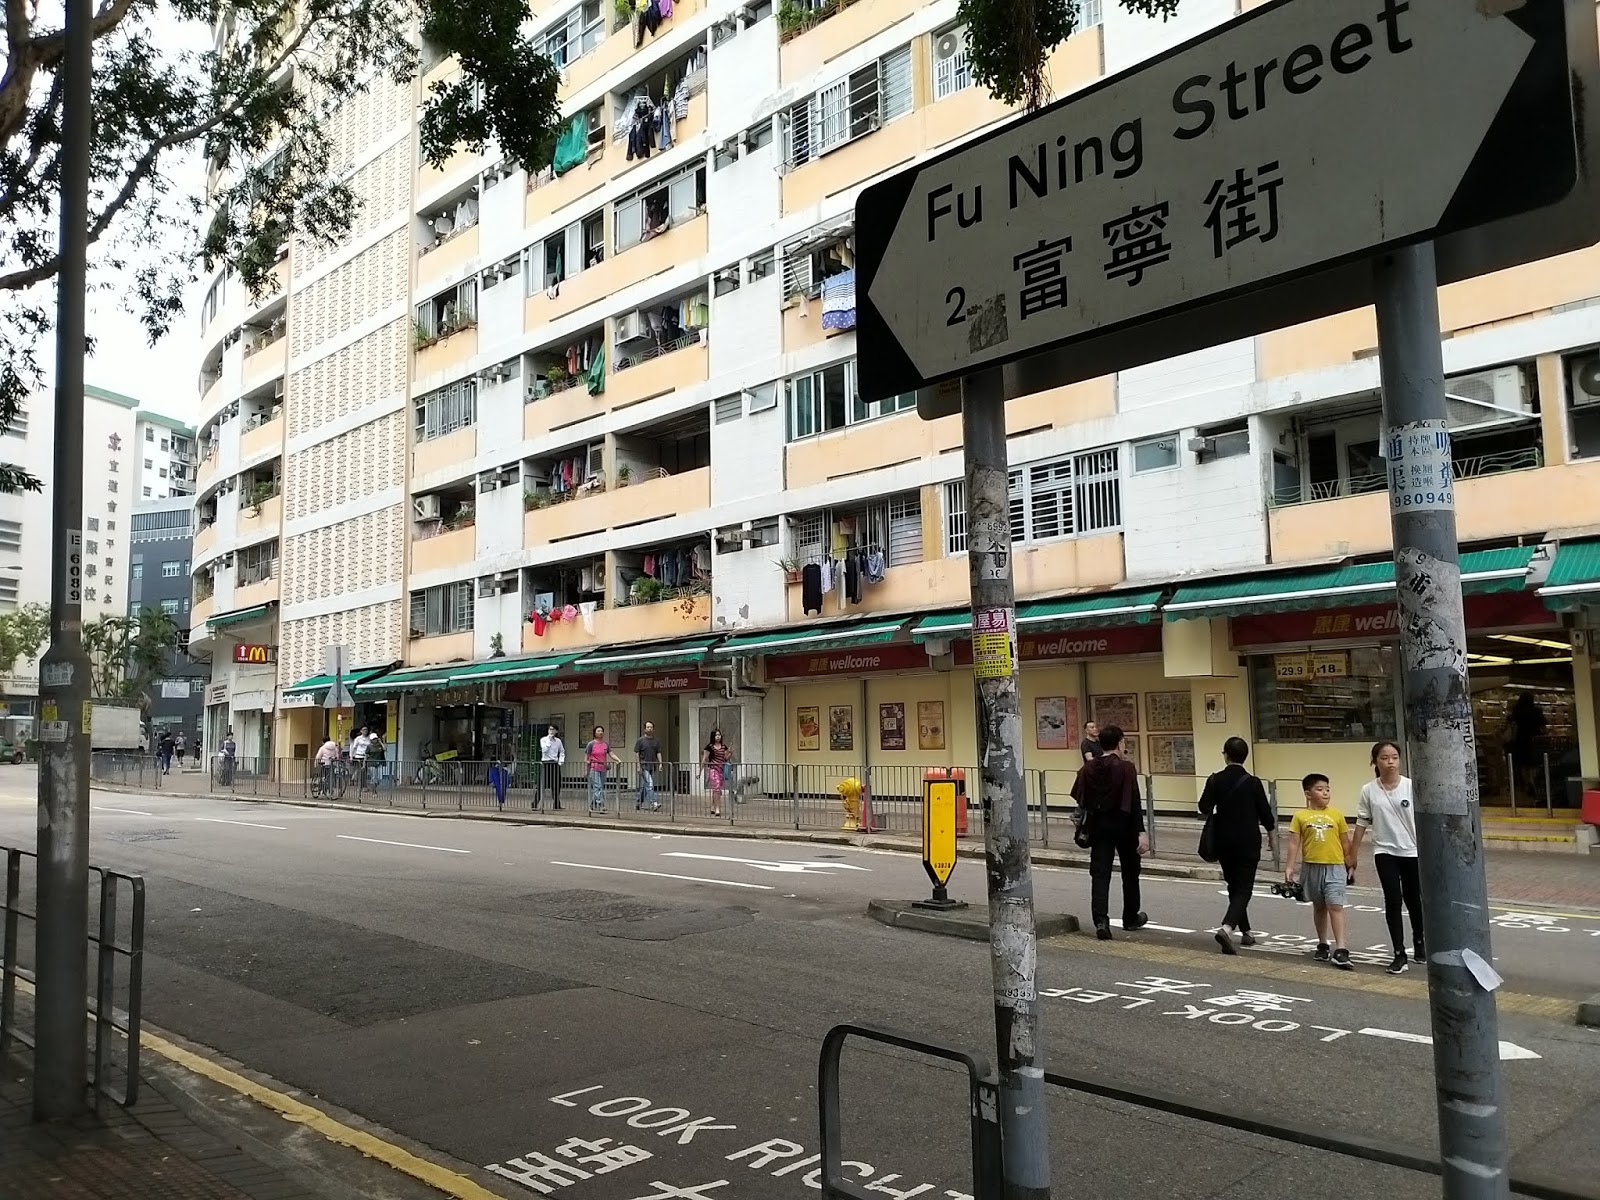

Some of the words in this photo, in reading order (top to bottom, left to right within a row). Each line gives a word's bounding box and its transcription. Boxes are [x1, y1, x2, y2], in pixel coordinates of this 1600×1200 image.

[926, 181, 983, 242] Fu
[1008, 116, 1143, 211] Ning
[1172, 0, 1413, 141] Street
[1012, 160, 1284, 321] 富寧街
[945, 286, 966, 328] 2
[70, 553, 80, 601] 6089
[1355, 608, 1399, 631] well
[1037, 637, 1108, 655] wellcome
[829, 654, 881, 670] wellcome
[549, 680, 579, 693] wellcome
[653, 676, 689, 689] wellcome
[1038, 986, 1156, 1009] LEF
[1162, 1003, 1354, 1043] LOOK
[547, 1084, 738, 1145] LOOK
[725, 1137, 976, 1200] RIGH
